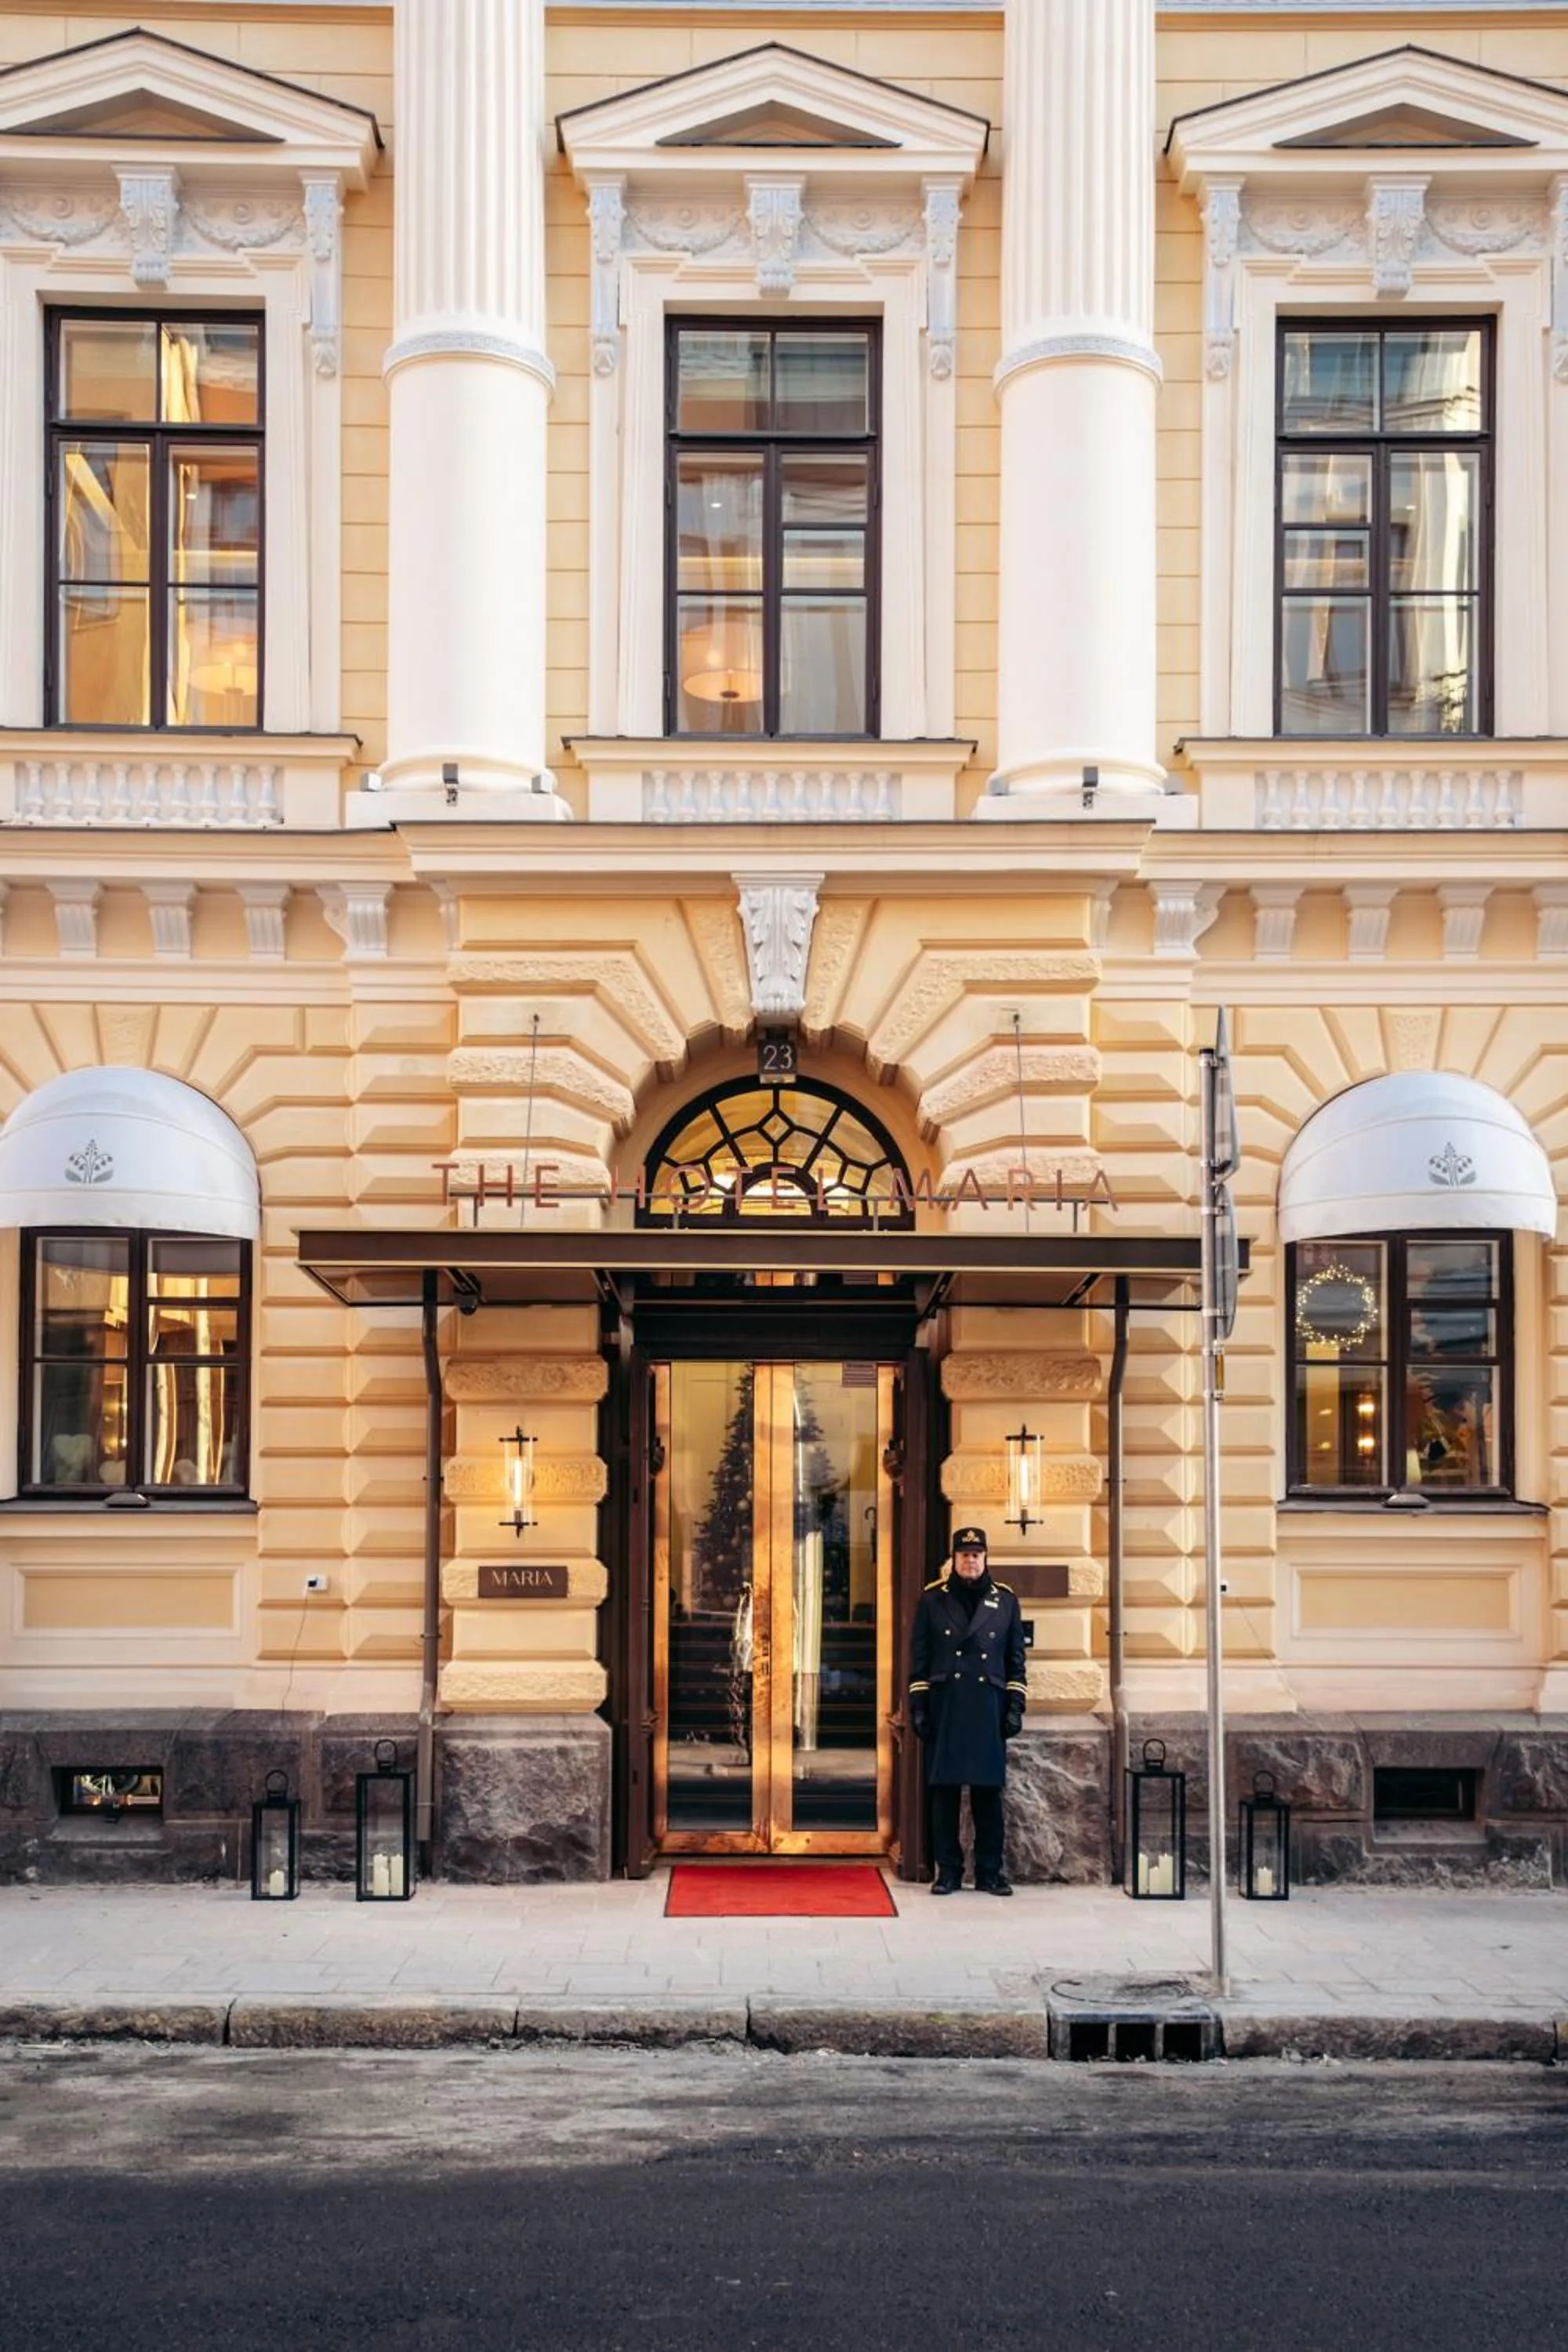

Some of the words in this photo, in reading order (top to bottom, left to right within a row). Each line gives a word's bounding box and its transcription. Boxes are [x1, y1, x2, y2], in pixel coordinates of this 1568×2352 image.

[763, 1044, 793, 1070] 23
[432, 1163, 560, 1208] THE
[611, 1165, 841, 1210] HOTEL
[889, 1167, 1119, 1212] MARIA
[492, 1570, 553, 1587] MARIA
